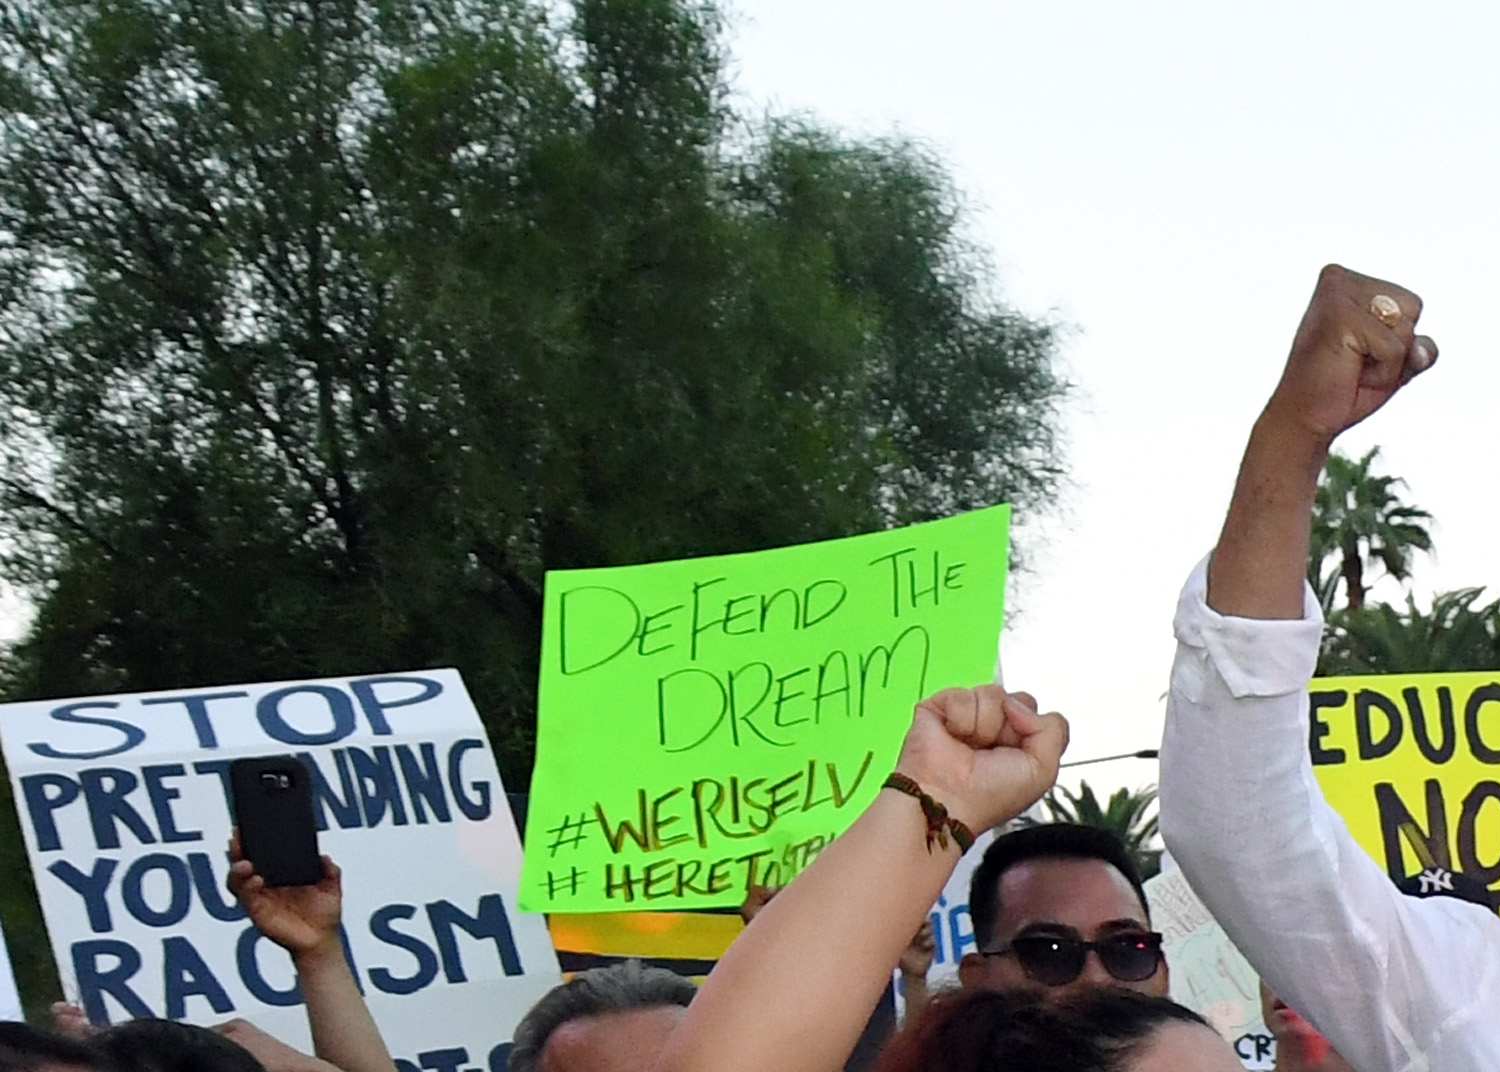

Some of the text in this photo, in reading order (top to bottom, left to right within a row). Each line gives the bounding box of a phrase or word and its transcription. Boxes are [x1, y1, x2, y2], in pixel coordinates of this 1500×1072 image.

[27, 675, 443, 760] STOP
[657, 624, 930, 753] DREAM
[20, 738, 491, 852] PRETNDING
[46, 851, 250, 932] YOU
[71, 893, 524, 1025] RACSM
